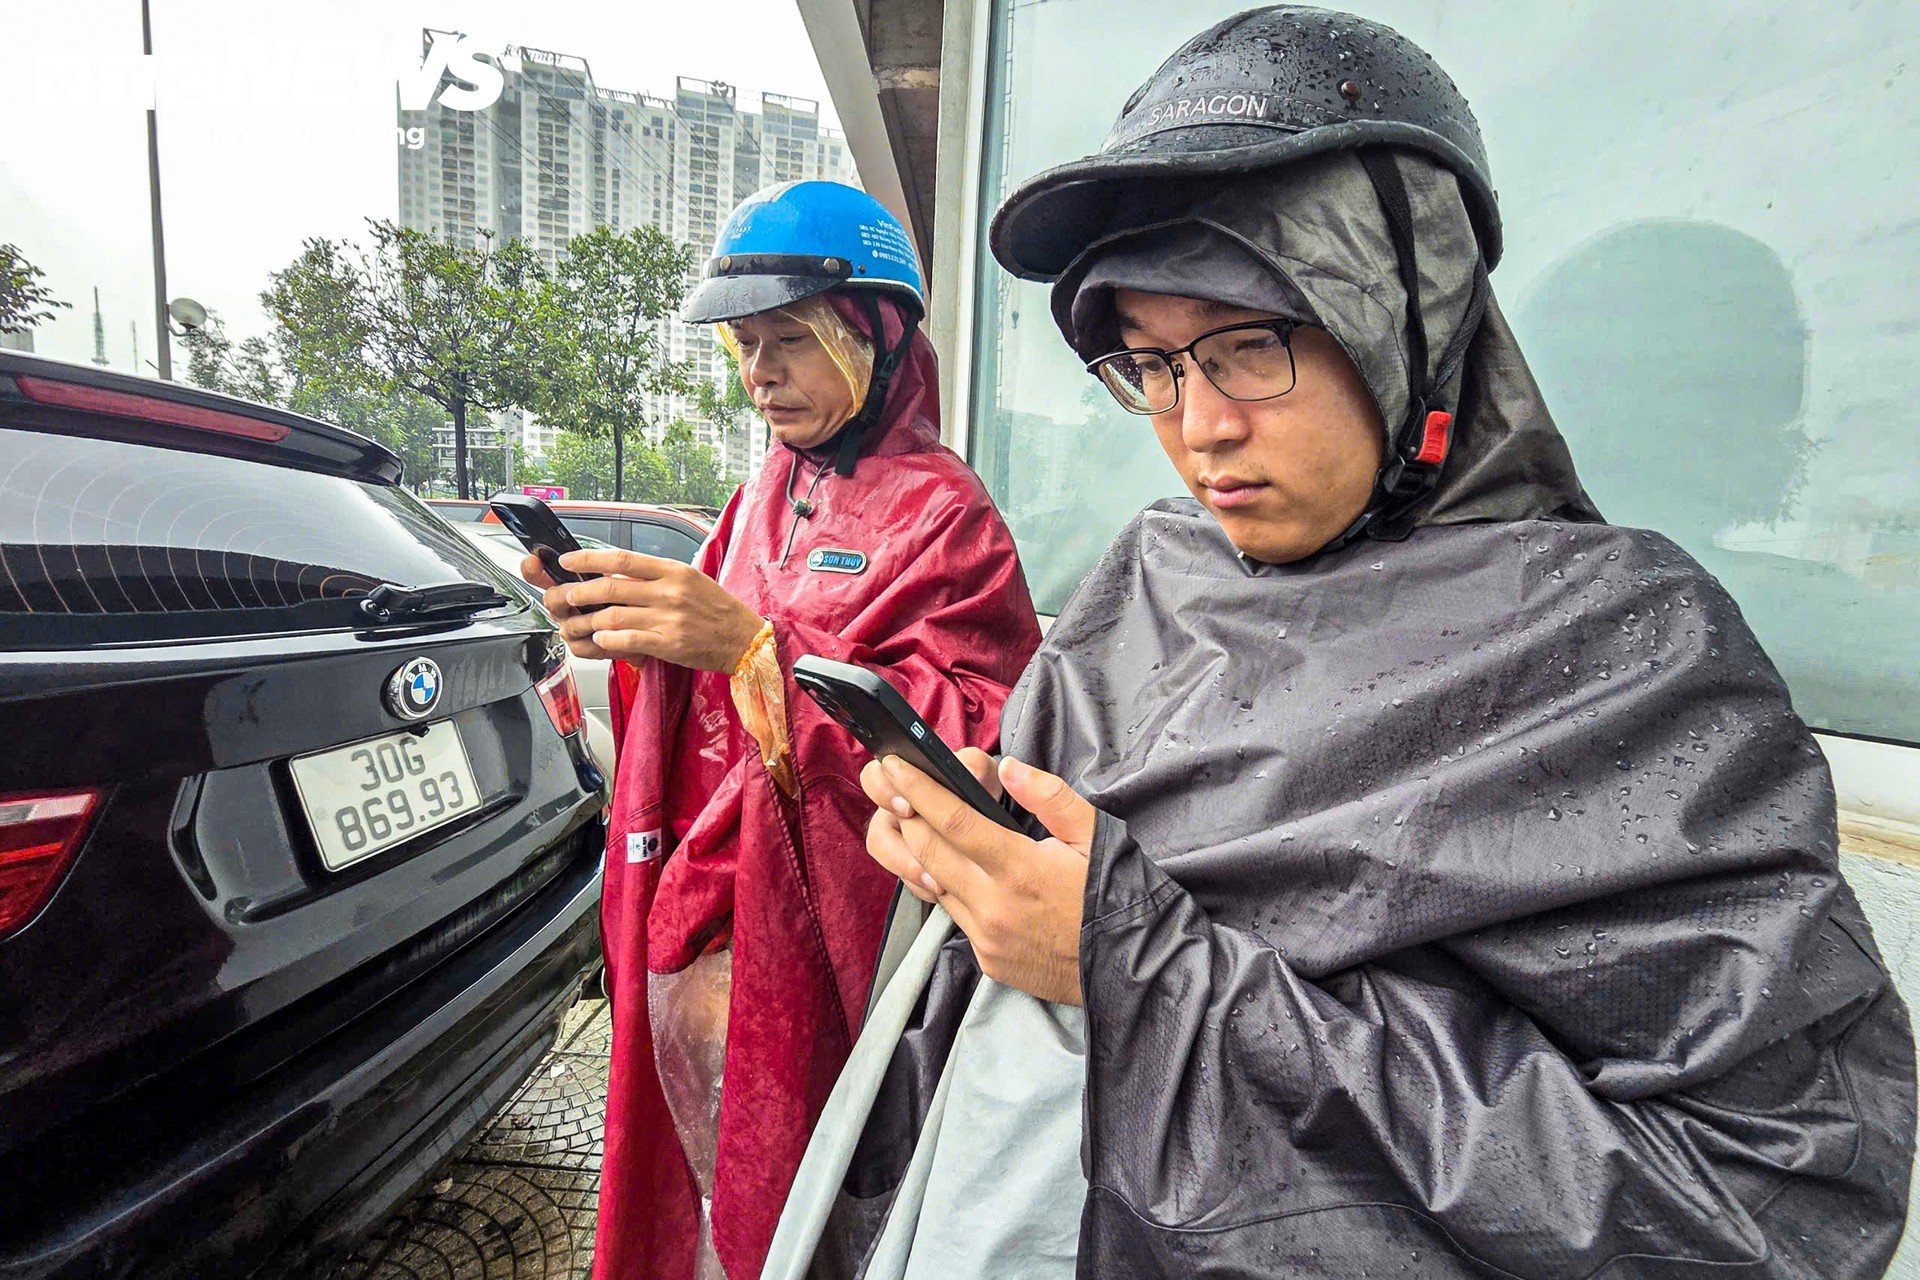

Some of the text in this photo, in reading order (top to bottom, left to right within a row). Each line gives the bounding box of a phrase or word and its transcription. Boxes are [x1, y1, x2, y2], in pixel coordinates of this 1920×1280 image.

[1149, 95, 1268, 125] SARAGON
[405, 663, 437, 683] BMW
[351, 737, 426, 791] 30G
[335, 771, 464, 851] 869.93
